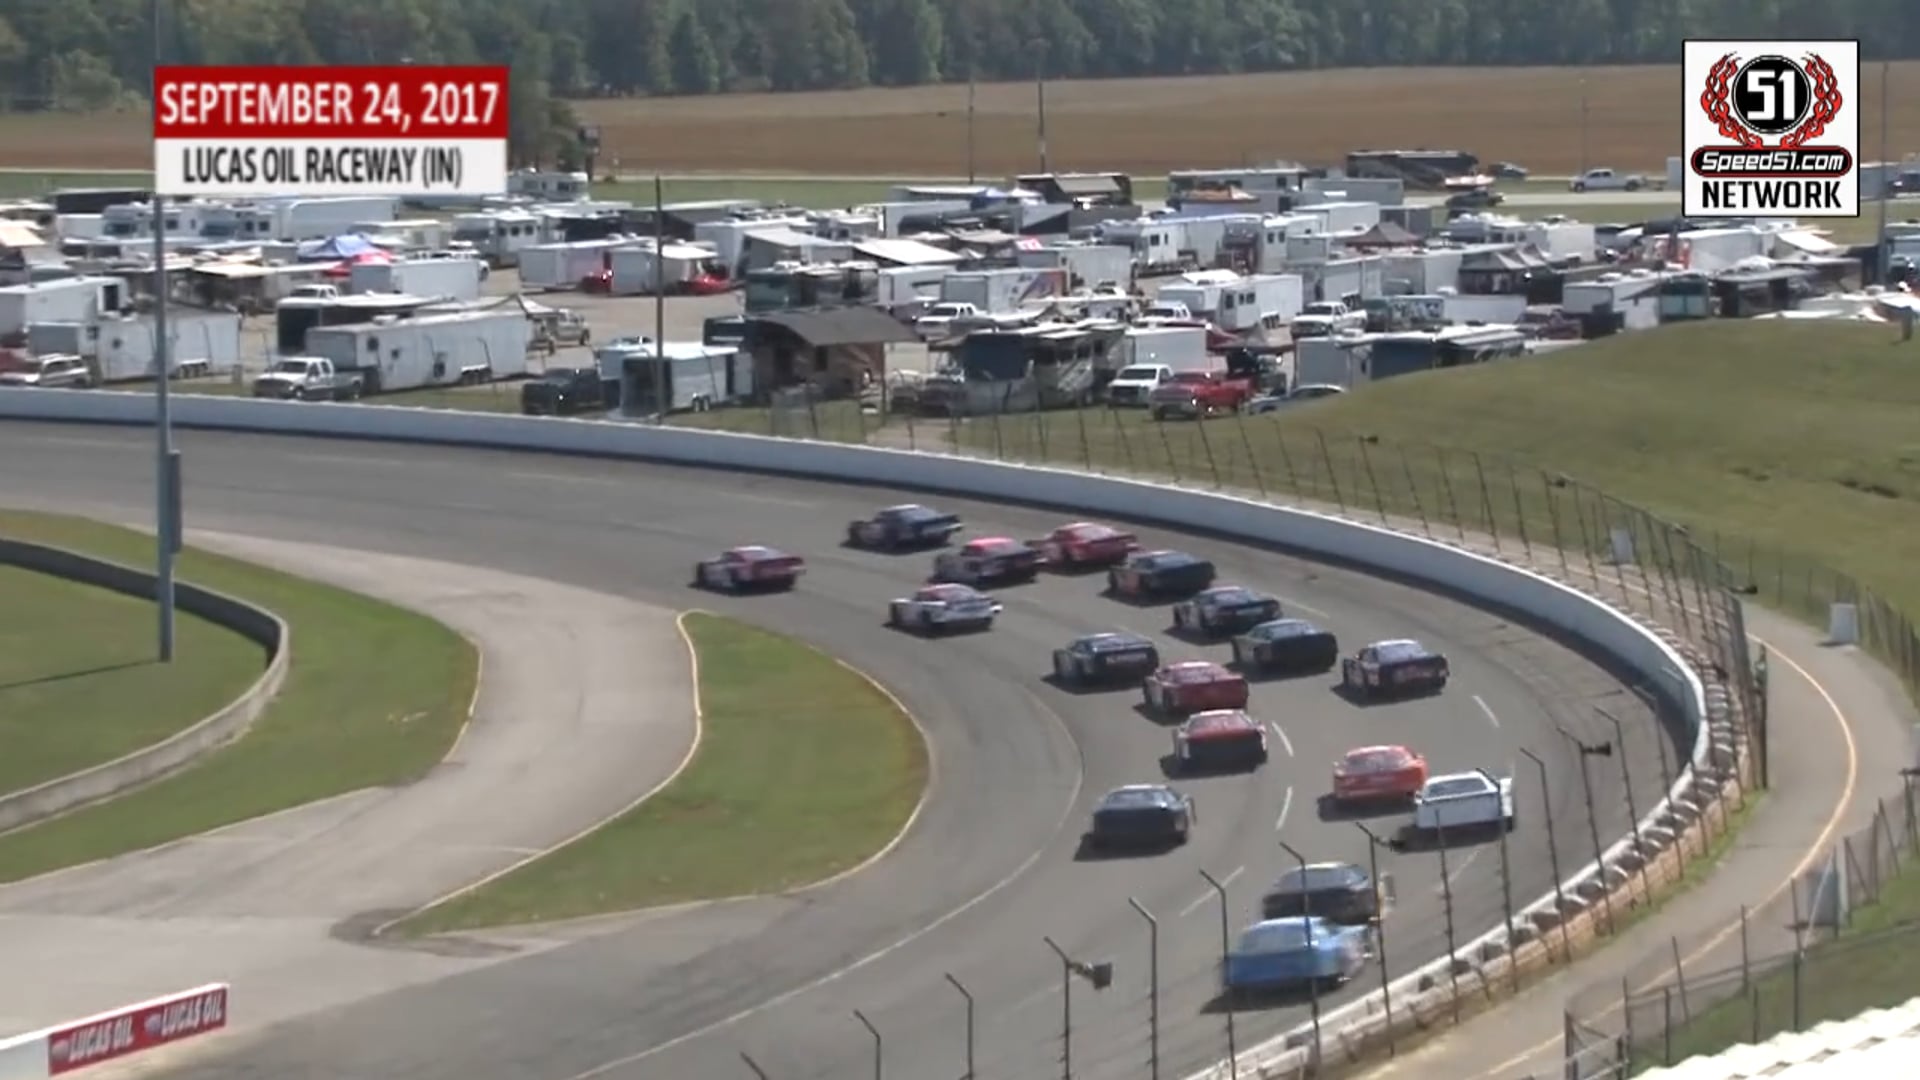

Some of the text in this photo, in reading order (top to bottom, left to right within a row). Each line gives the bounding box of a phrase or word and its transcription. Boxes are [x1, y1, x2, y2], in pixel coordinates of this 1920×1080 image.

[161, 991, 222, 1037] LUCAS OIL
[69, 1015, 134, 1062] LUCAS OIL
